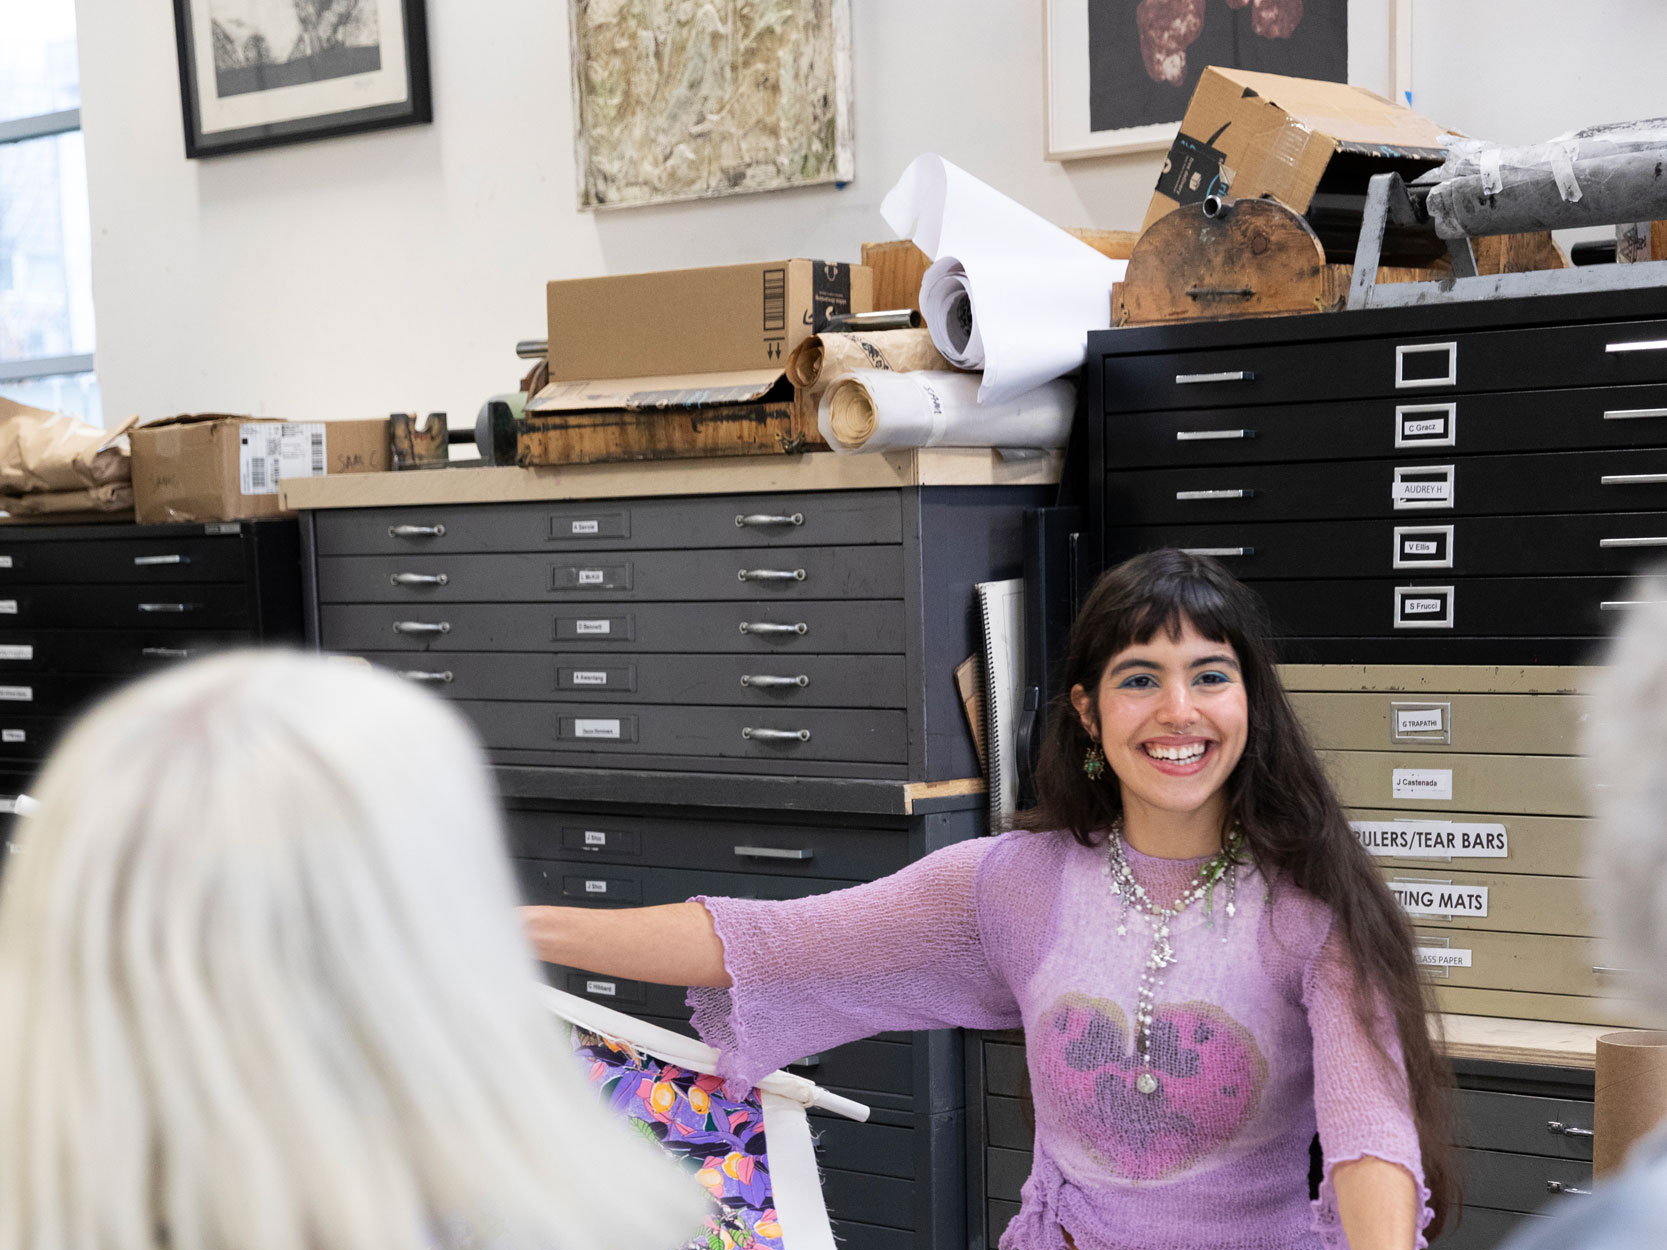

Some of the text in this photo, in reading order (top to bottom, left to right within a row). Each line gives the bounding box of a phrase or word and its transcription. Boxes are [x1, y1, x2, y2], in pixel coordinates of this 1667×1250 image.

[1408, 424, 1415, 432] C
[1404, 485, 1442, 494] AUDREY H
[1409, 543, 1430, 551] V Ellis
[1409, 602, 1438, 610] S Frucci
[1396, 778, 1438, 787] J Castenada
[1462, 832, 1505, 850] BARS
[1438, 892, 1483, 910] MATS
[1438, 956, 1463, 965] PAPER
